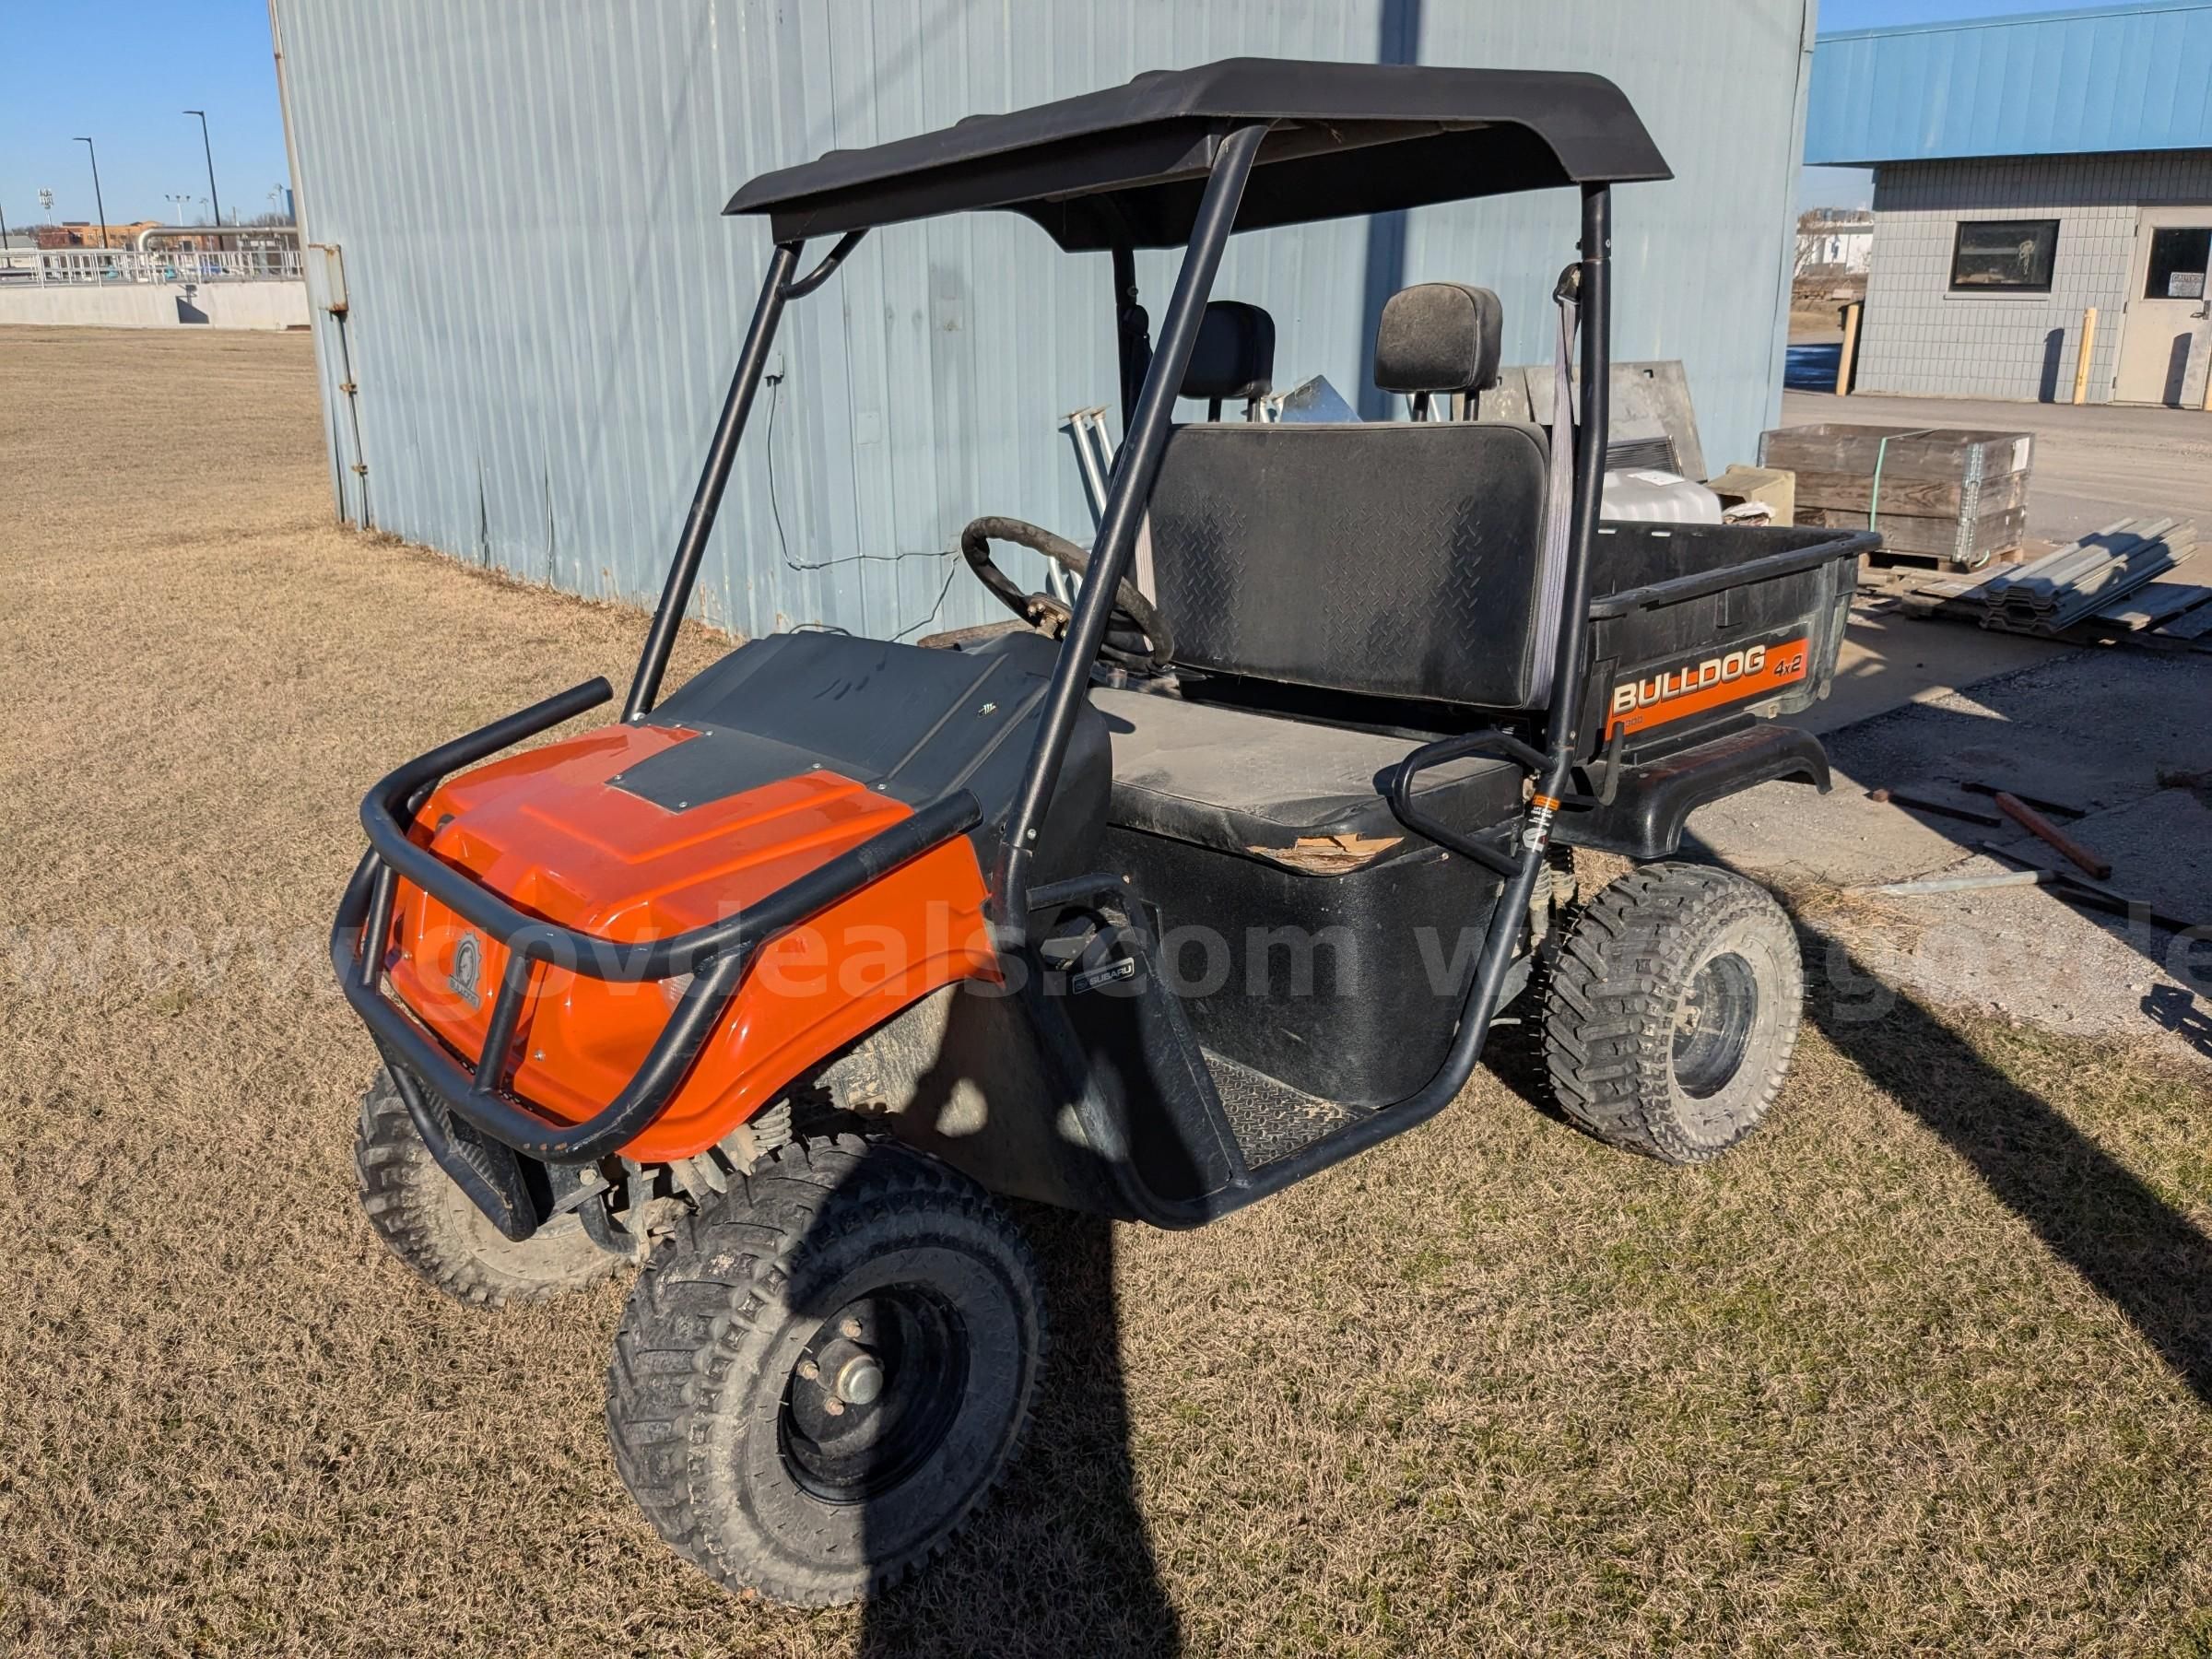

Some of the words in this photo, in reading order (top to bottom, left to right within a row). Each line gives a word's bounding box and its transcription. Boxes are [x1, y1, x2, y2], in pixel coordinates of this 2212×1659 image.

[1613, 644, 1767, 715] BULLDOG
[1773, 654, 1803, 677] 4x2
[1089, 965, 1132, 984] SUBARU
